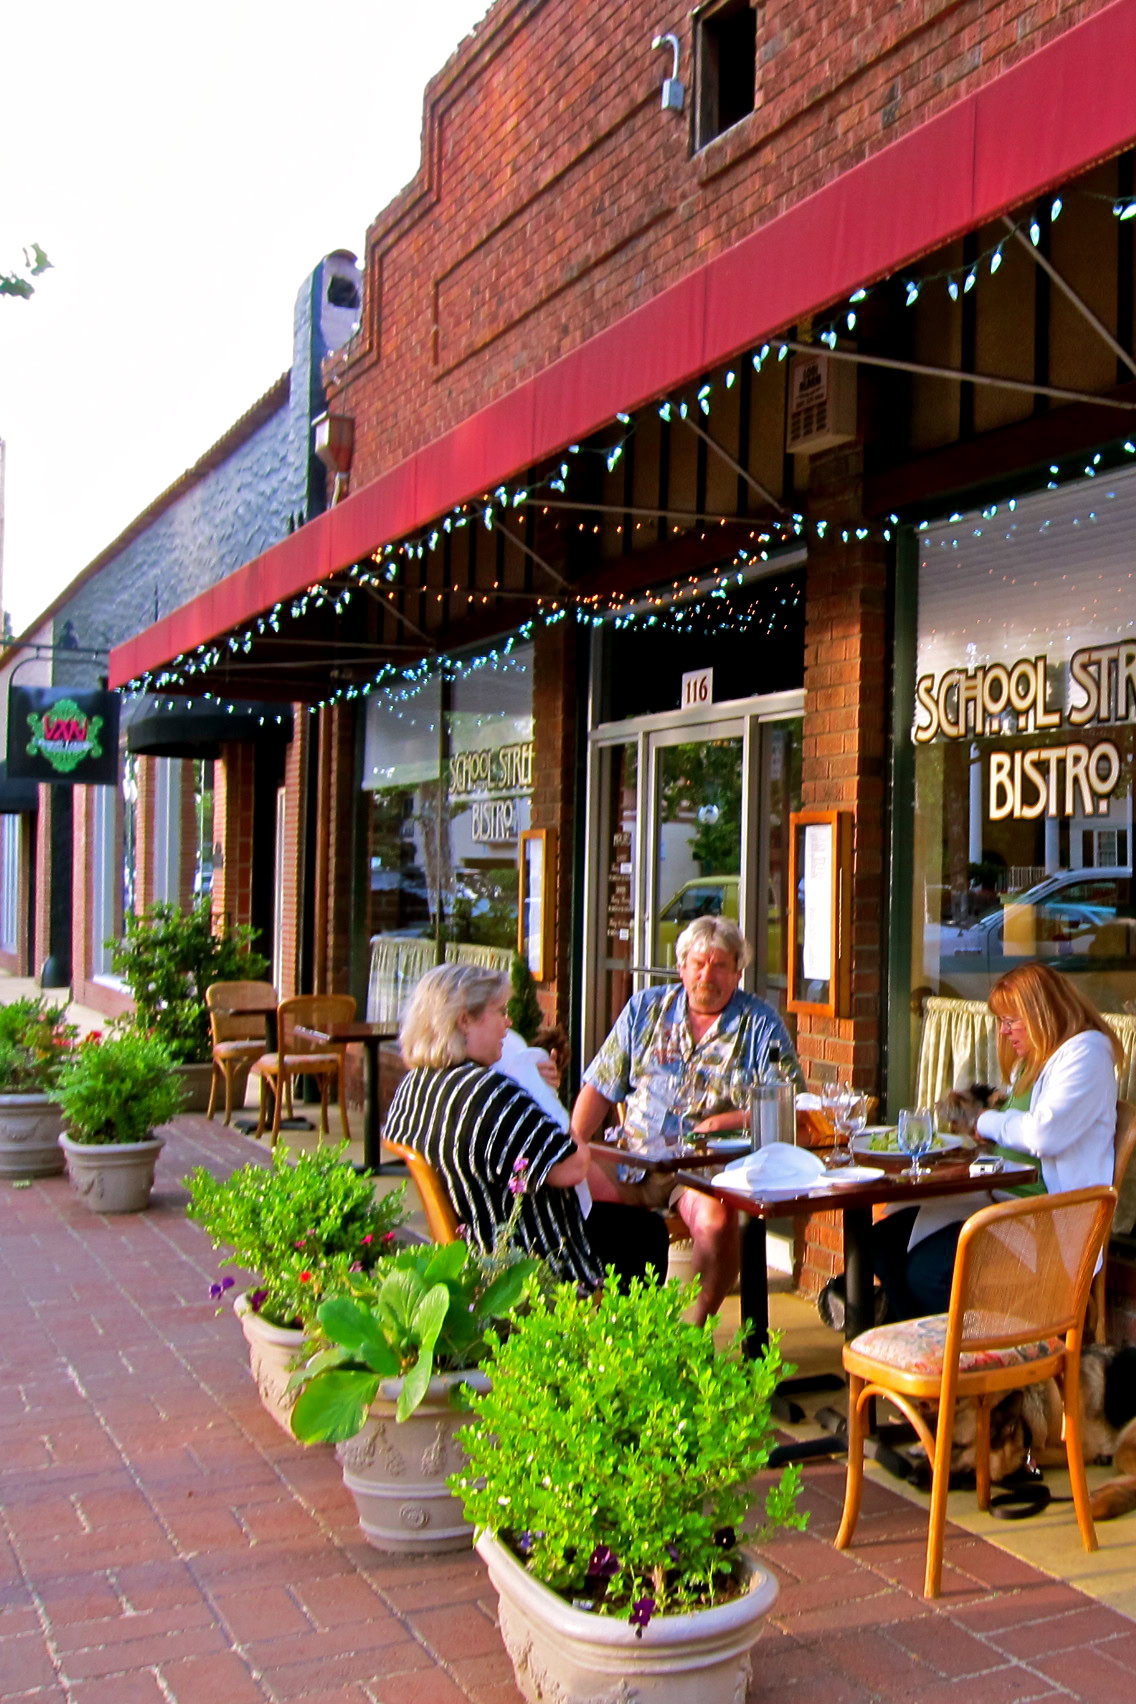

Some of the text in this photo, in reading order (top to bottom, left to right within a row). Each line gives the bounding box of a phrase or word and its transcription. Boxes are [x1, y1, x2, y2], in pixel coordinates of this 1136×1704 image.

[686, 675, 708, 704] 116
[914, 654, 1062, 744] SCHOOL
[449, 743, 536, 795] SCHOOL STREE
[988, 740, 1121, 821] BISTRO
[471, 799, 514, 840] BISTRO
